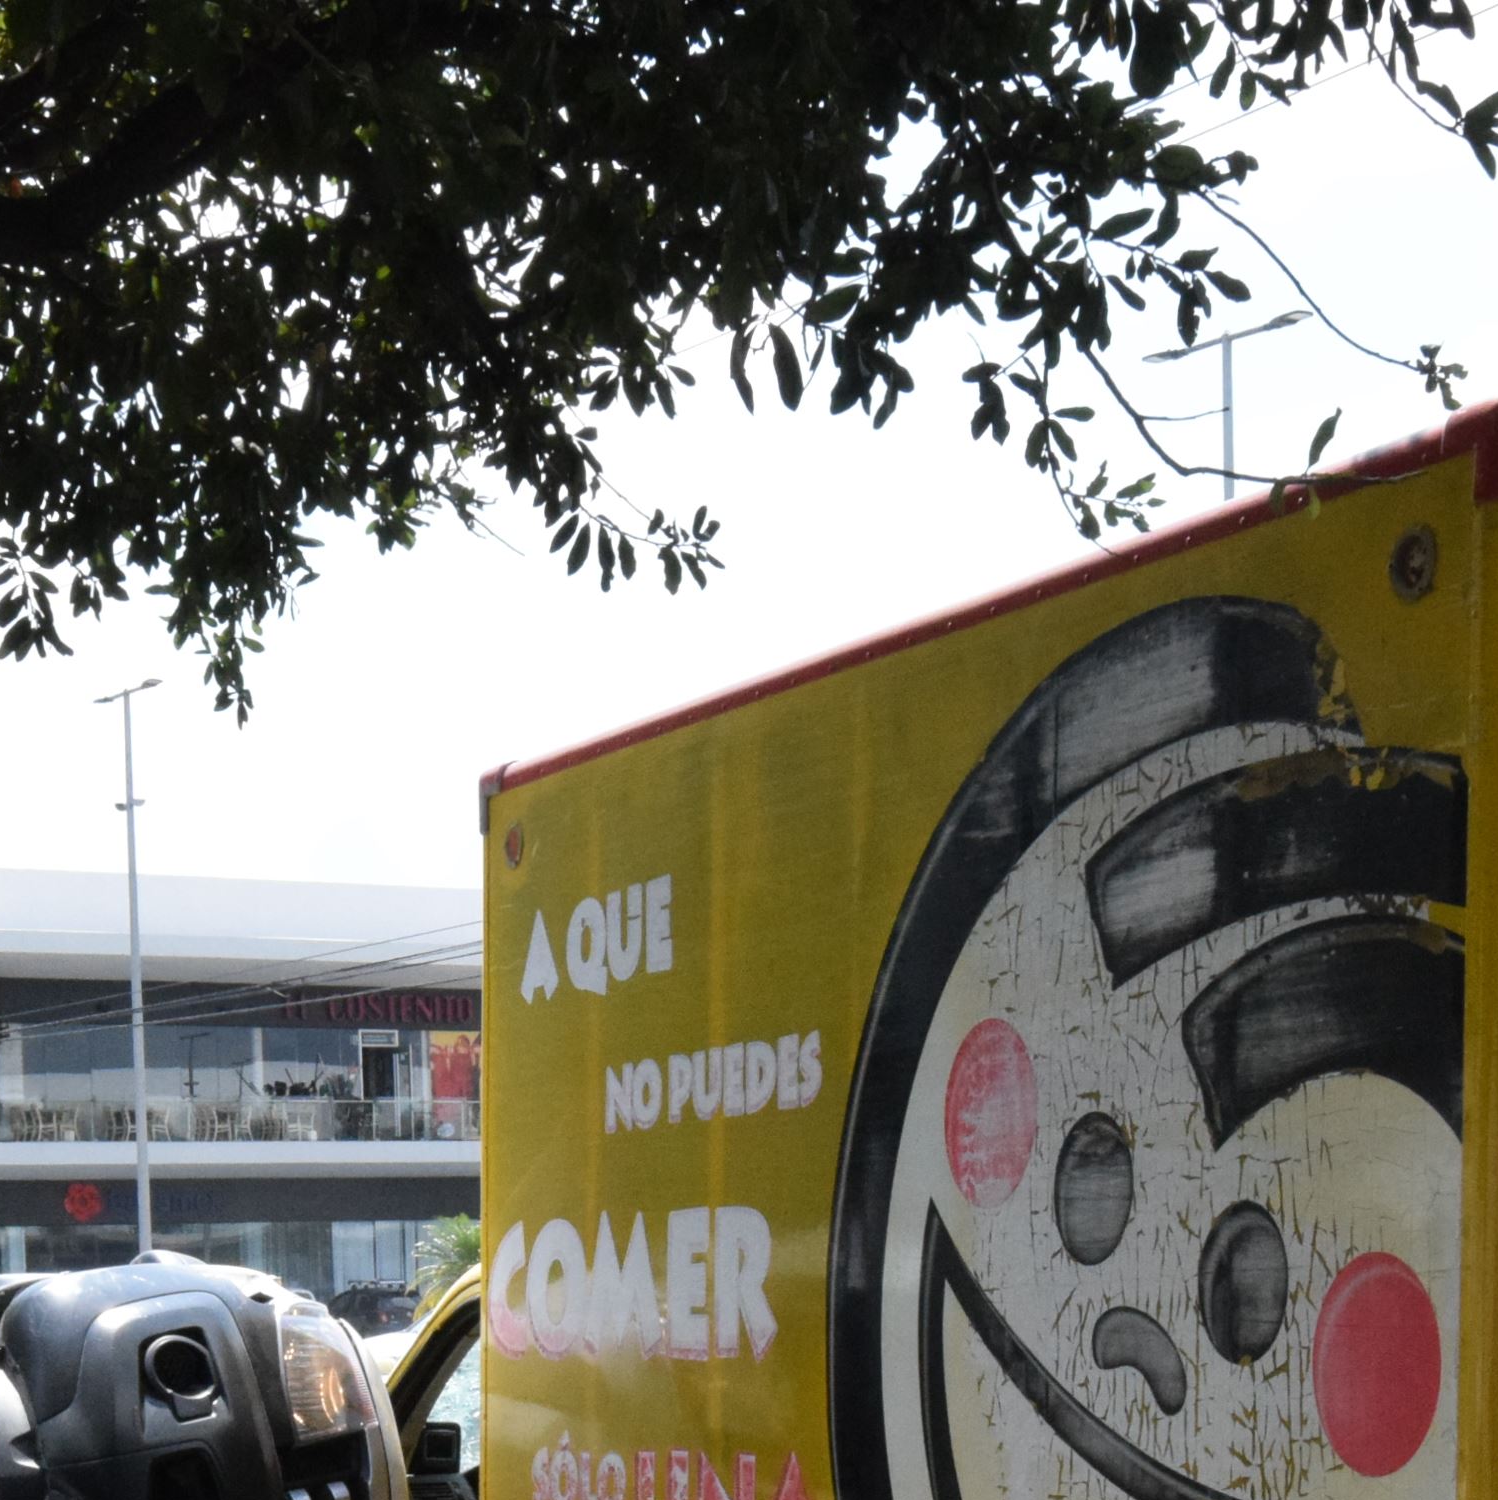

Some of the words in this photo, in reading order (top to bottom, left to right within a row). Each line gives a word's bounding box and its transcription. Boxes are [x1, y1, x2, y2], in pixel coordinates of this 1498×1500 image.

[520, 908, 559, 1005] A
[566, 873, 673, 996] QUE
[604, 1058, 662, 1134] NO
[668, 1029, 823, 1124] PUEDES
[487, 1206, 778, 1363] COMER
